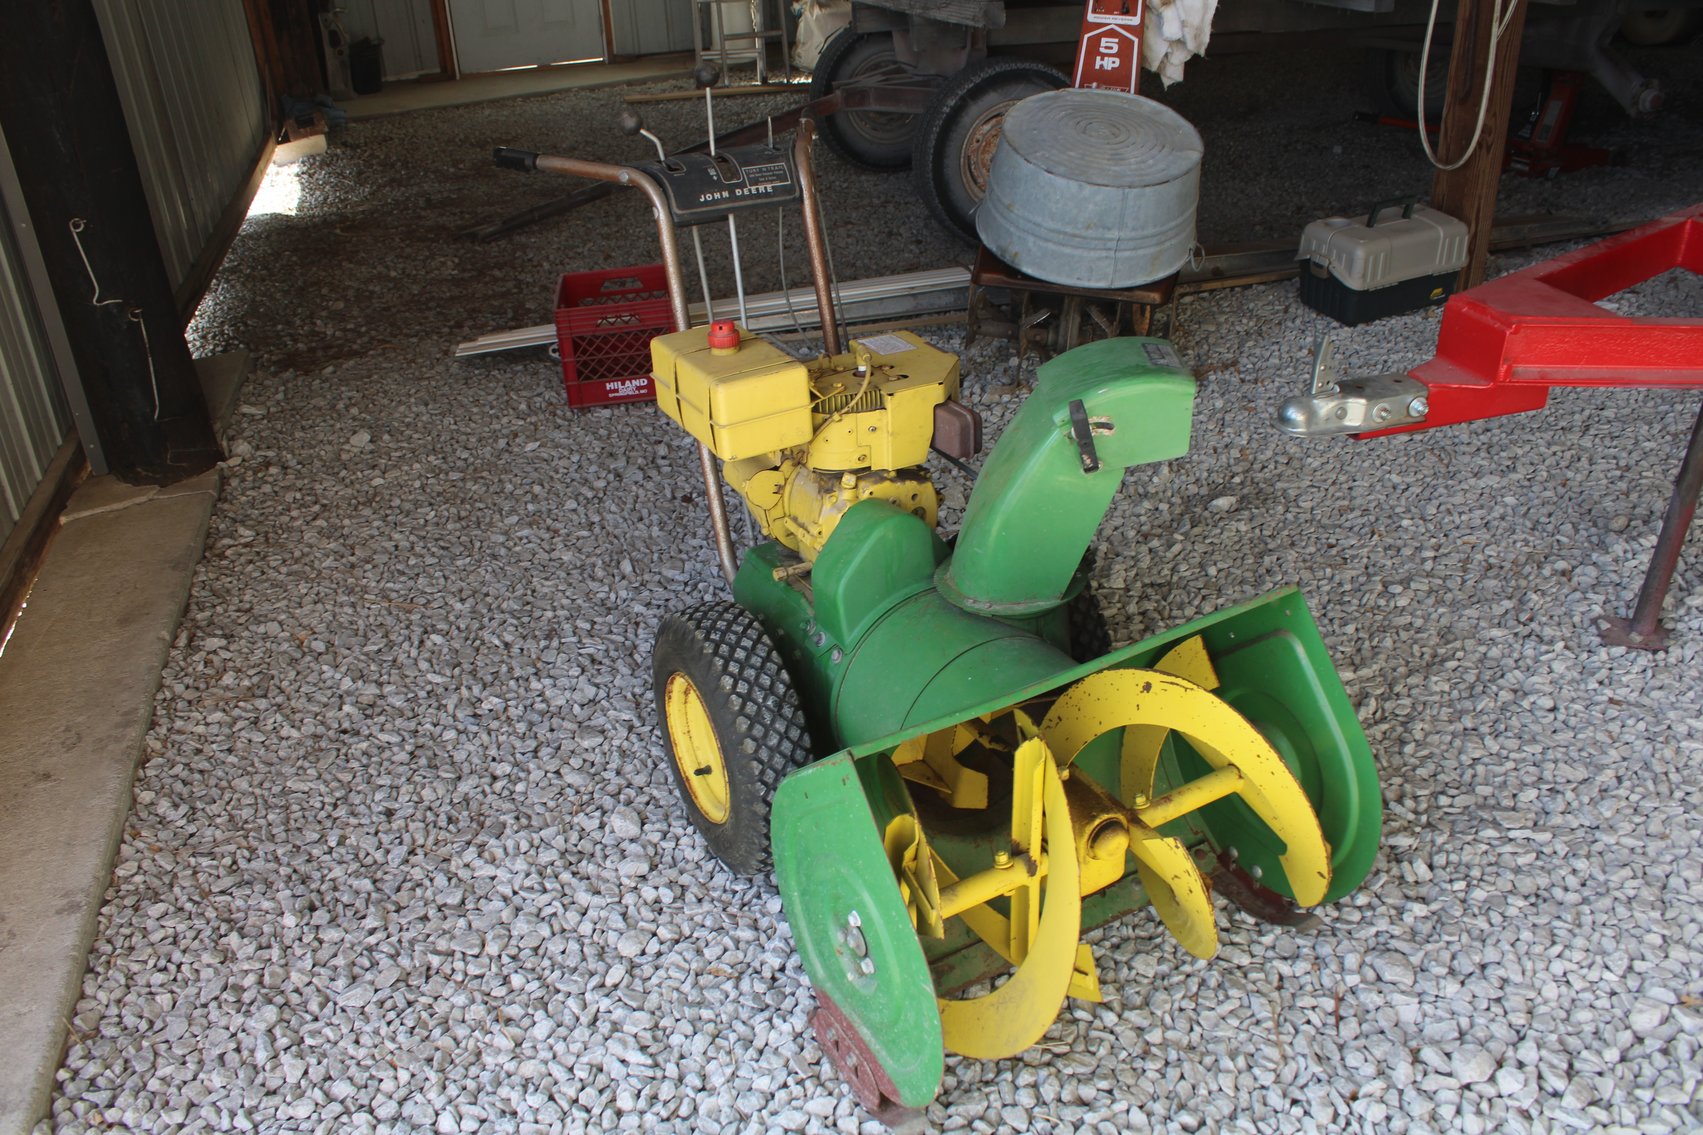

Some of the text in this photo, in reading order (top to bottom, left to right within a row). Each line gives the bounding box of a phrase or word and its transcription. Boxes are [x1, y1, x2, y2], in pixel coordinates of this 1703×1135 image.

[1099, 37, 1119, 54] 5
[1094, 56, 1120, 71] HP
[699, 185, 774, 202] JOHN DEERE
[605, 378, 648, 390] HILAND
